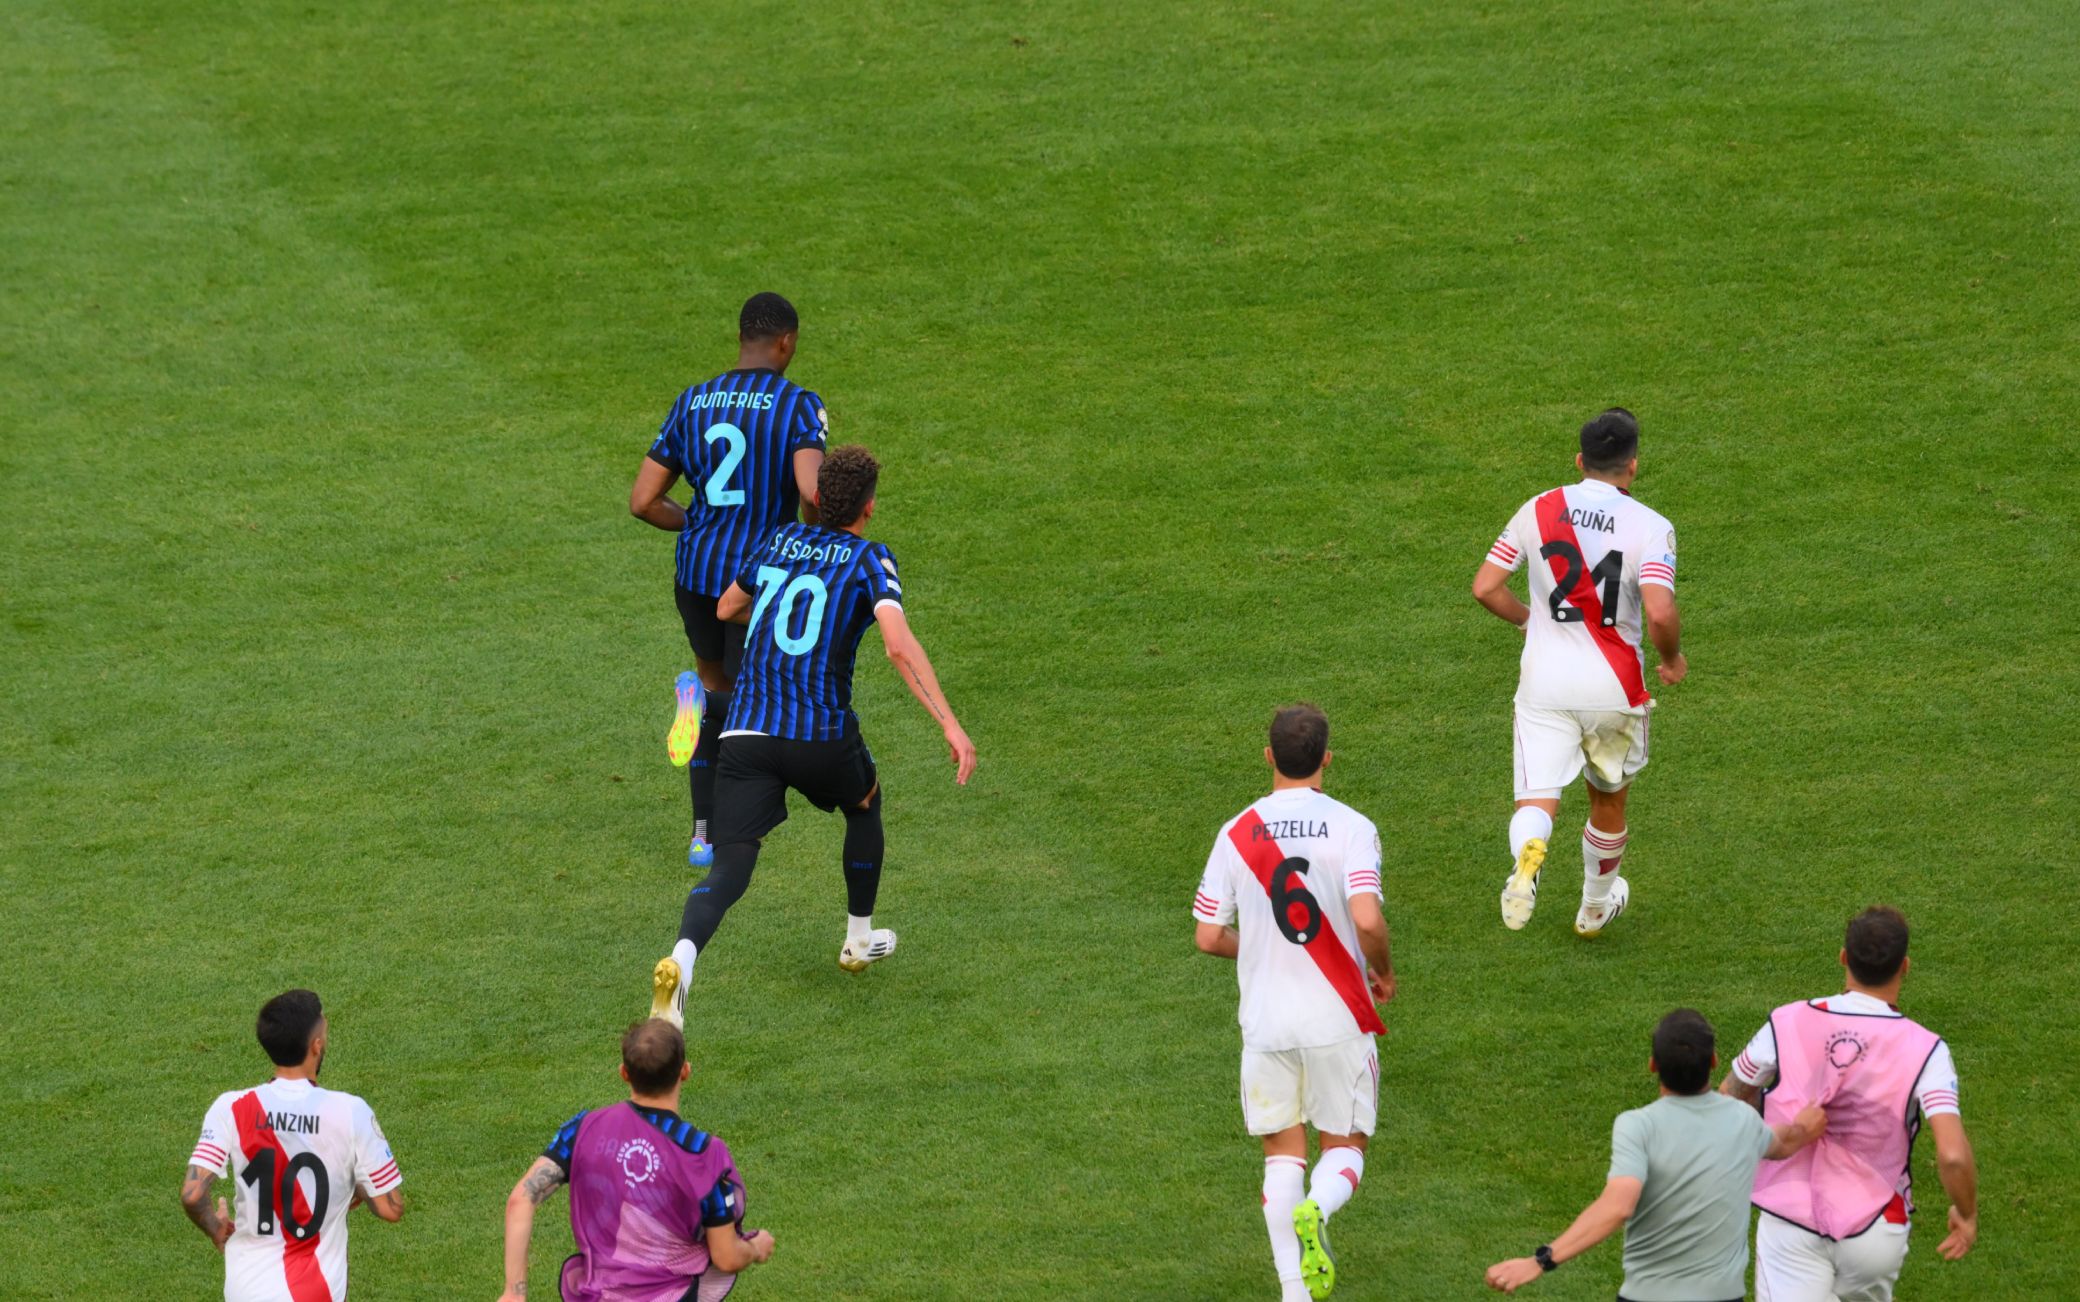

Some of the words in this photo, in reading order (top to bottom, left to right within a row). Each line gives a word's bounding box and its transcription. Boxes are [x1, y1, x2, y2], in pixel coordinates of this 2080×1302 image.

[690, 391, 774, 411] DUMFRIES
[704, 422, 747, 507] 2
[1558, 508, 1615, 534] ACUÑA
[743, 565, 828, 656] 70
[1539, 540, 1624, 627] 21
[1252, 820, 1329, 842] PEZZELLA
[1271, 856, 1322, 945] 6
[255, 1111, 320, 1135] LANZINI
[241, 1147, 330, 1241] 10
